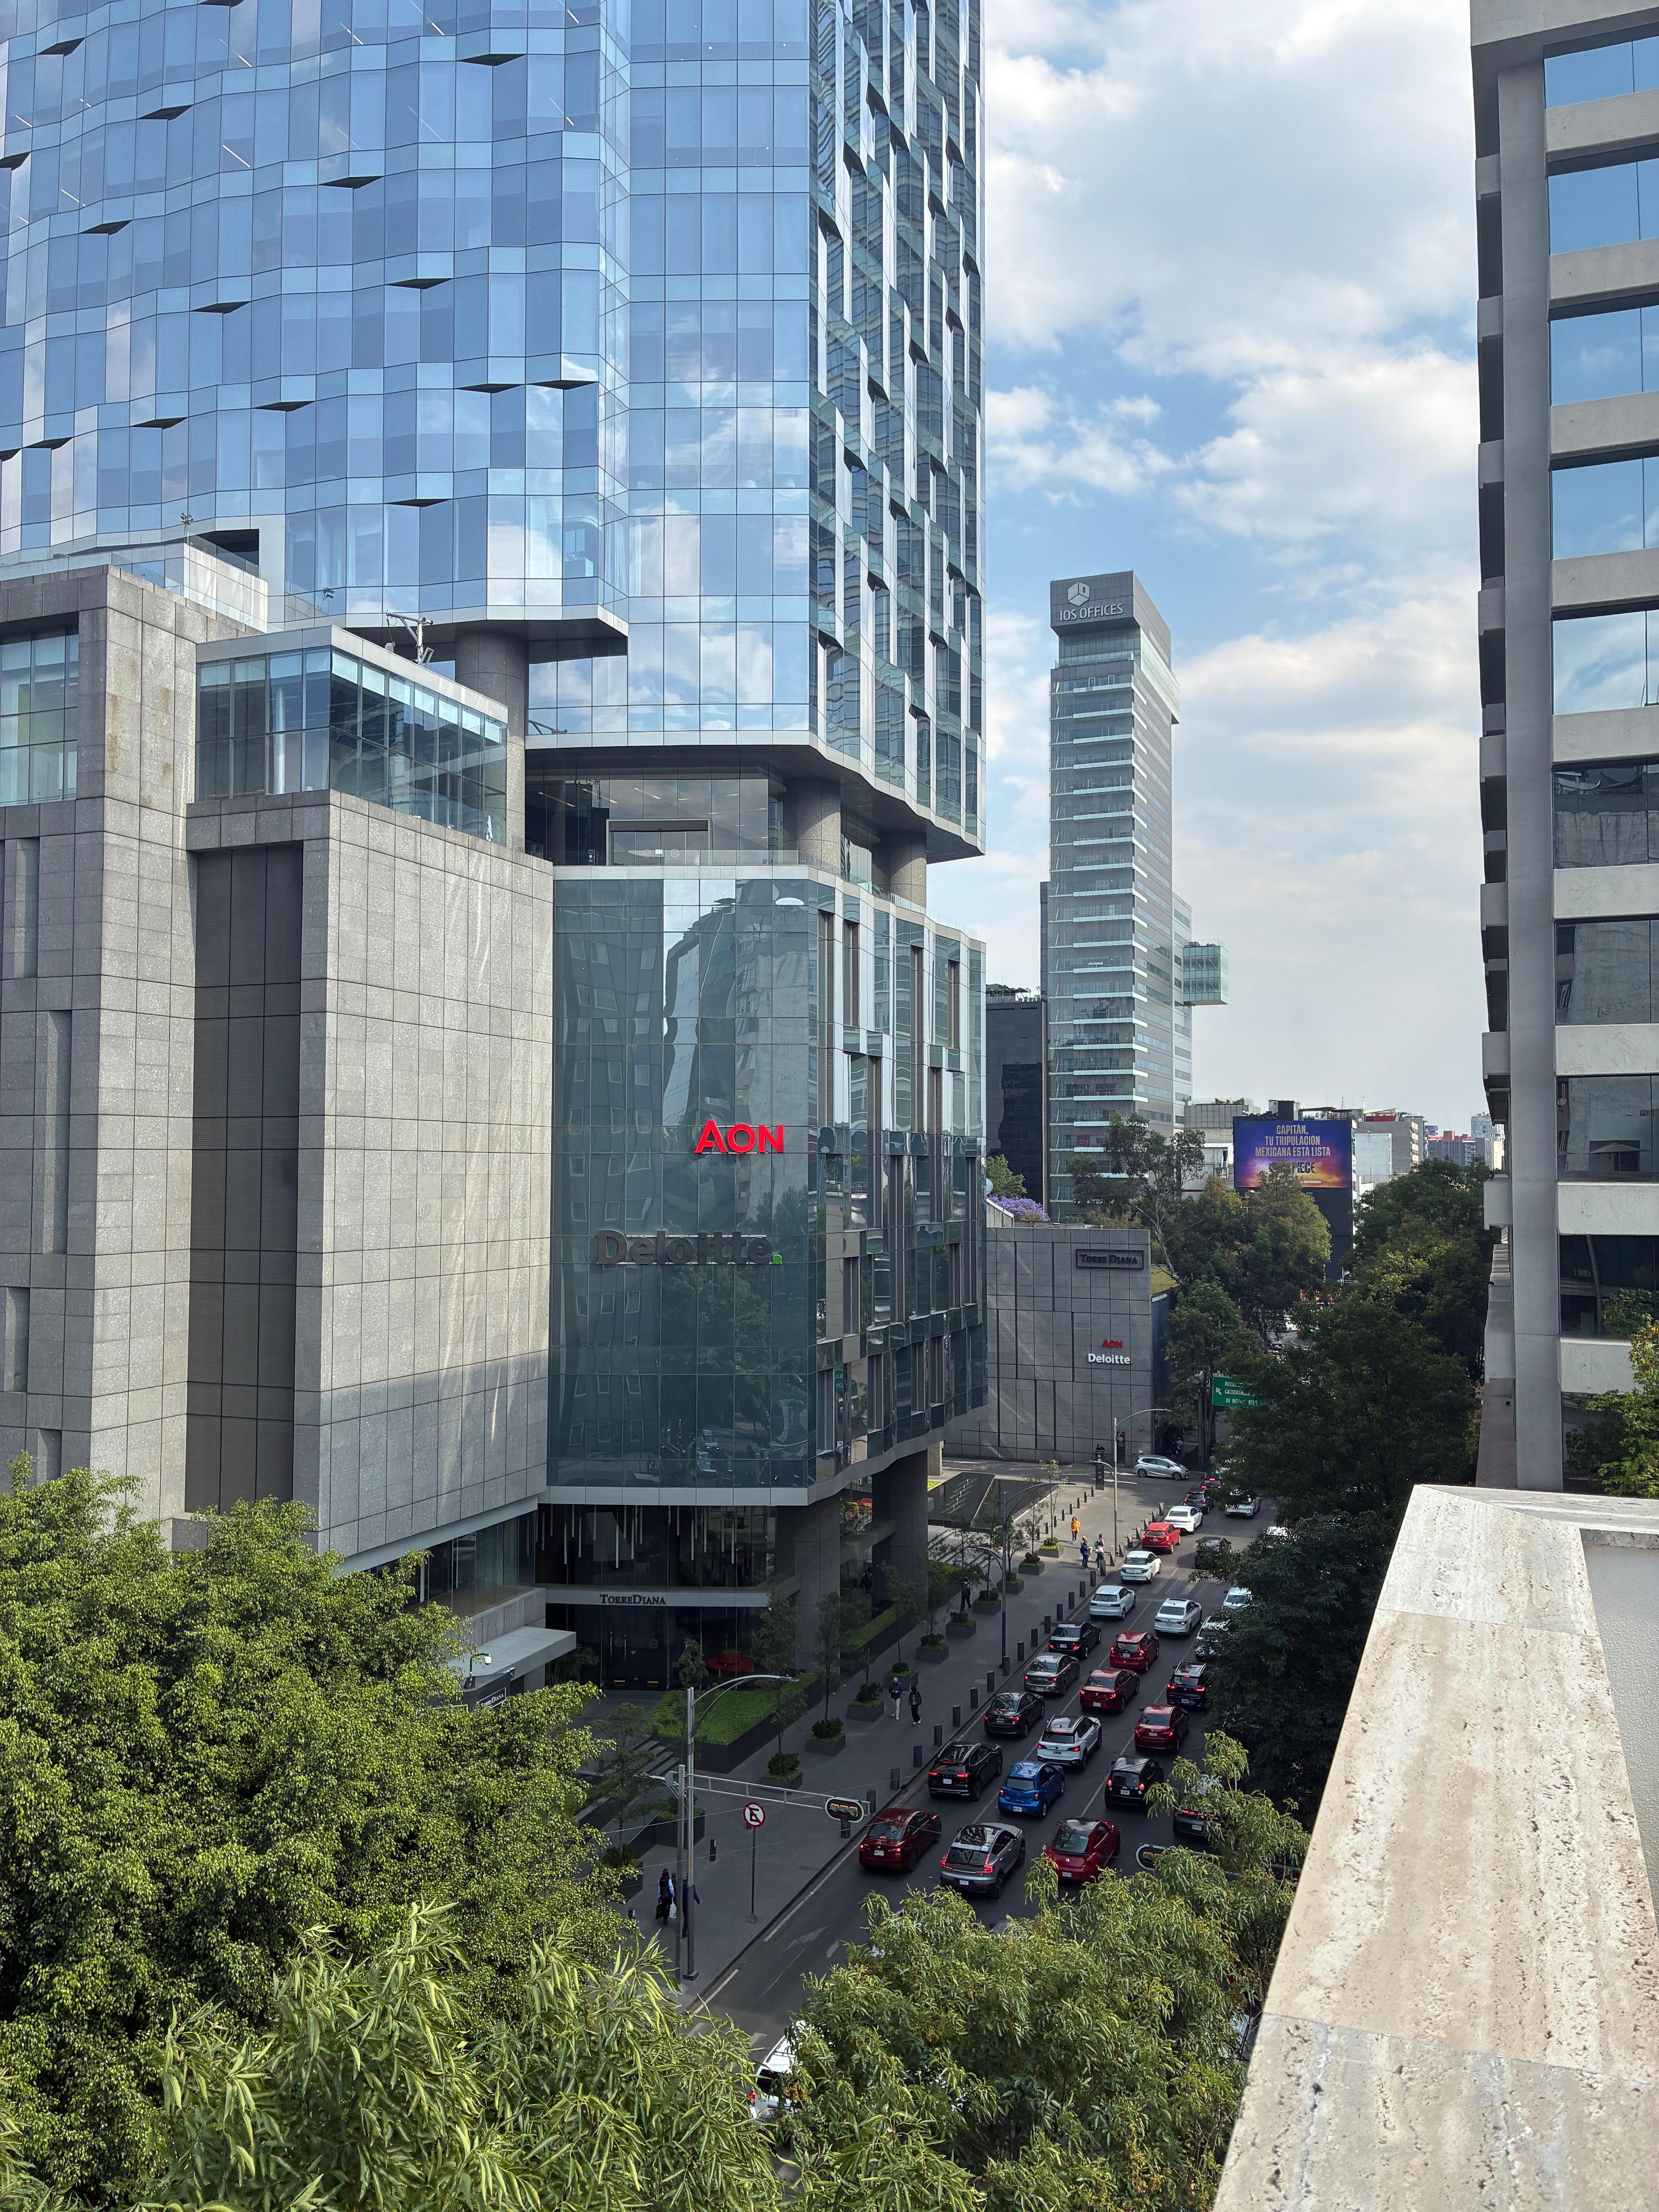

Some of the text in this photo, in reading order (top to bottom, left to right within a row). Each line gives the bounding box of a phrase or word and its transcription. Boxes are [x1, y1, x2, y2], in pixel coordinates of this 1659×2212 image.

[1060, 603, 1123, 622] IOS OFFICES
[1276, 1124, 1308, 1135] CAPITÁN,
[695, 1120, 784, 1154] AON
[1265, 1135, 1320, 1146] TU TRIPULACIÓN
[1255, 1146, 1331, 1157] MEXICANA ESTÁ LISTA
[596, 1230, 783, 1265] Deloitte.
[1102, 1339, 1123, 1348] AON
